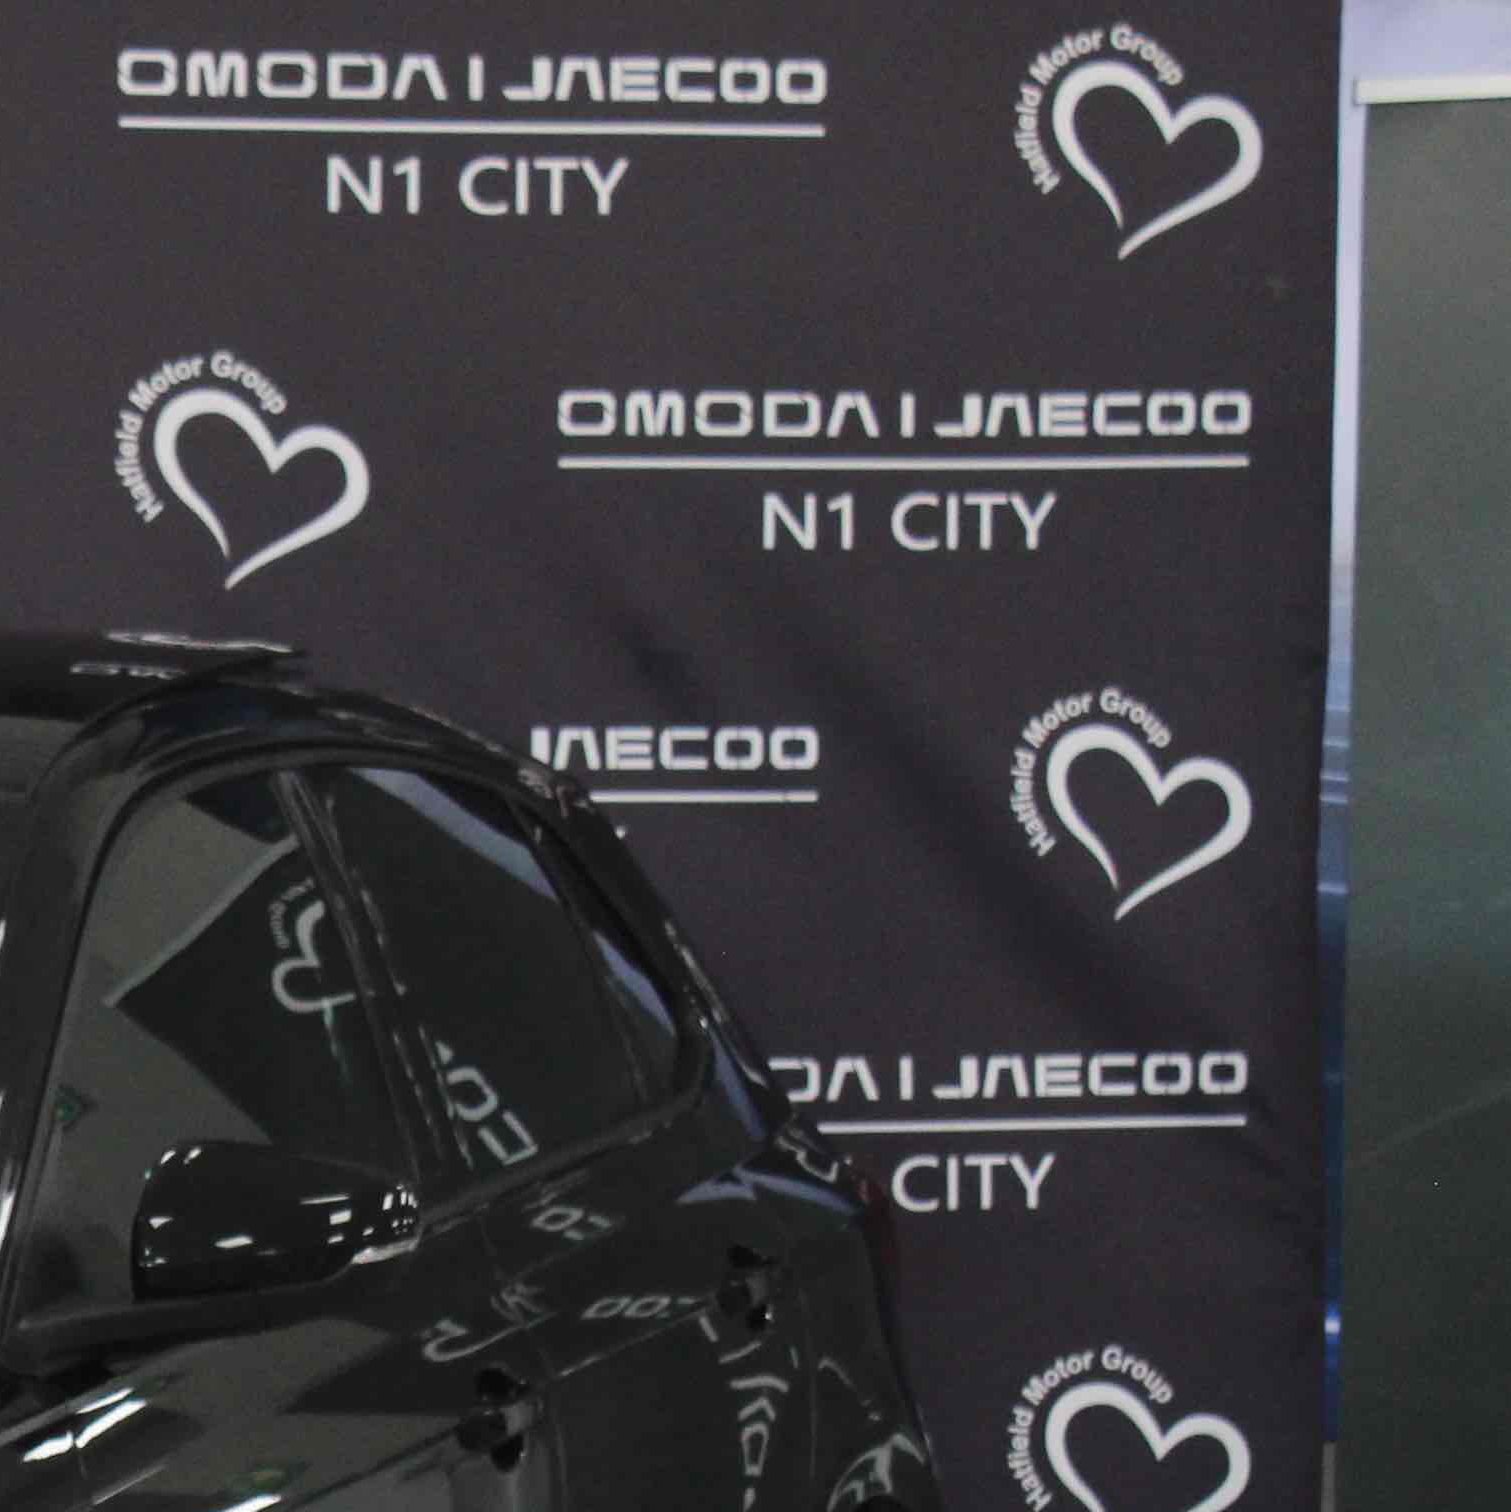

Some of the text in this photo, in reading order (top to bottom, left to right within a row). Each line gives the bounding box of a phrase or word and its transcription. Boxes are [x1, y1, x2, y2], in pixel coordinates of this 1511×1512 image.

[117, 49, 447, 101] OMODA
[502, 56, 827, 104] JAECOO
[1014, 22, 1183, 194] Hatfield Motor Group
[327, 155, 629, 216] N1 CITY
[114, 350, 287, 522] Hatfield Motor Group
[557, 390, 879, 438] OMODA
[934, 391, 1252, 438] JAECOO
[762, 492, 1056, 551] N1 CITY
[1010, 686, 1171, 857] Hatfield Motor Group
[932, 1052, 1248, 1100] JAECOO
[891, 1153, 1055, 1212] CITY
[1007, 1344, 1173, 1512] Hatfield Motor Group
